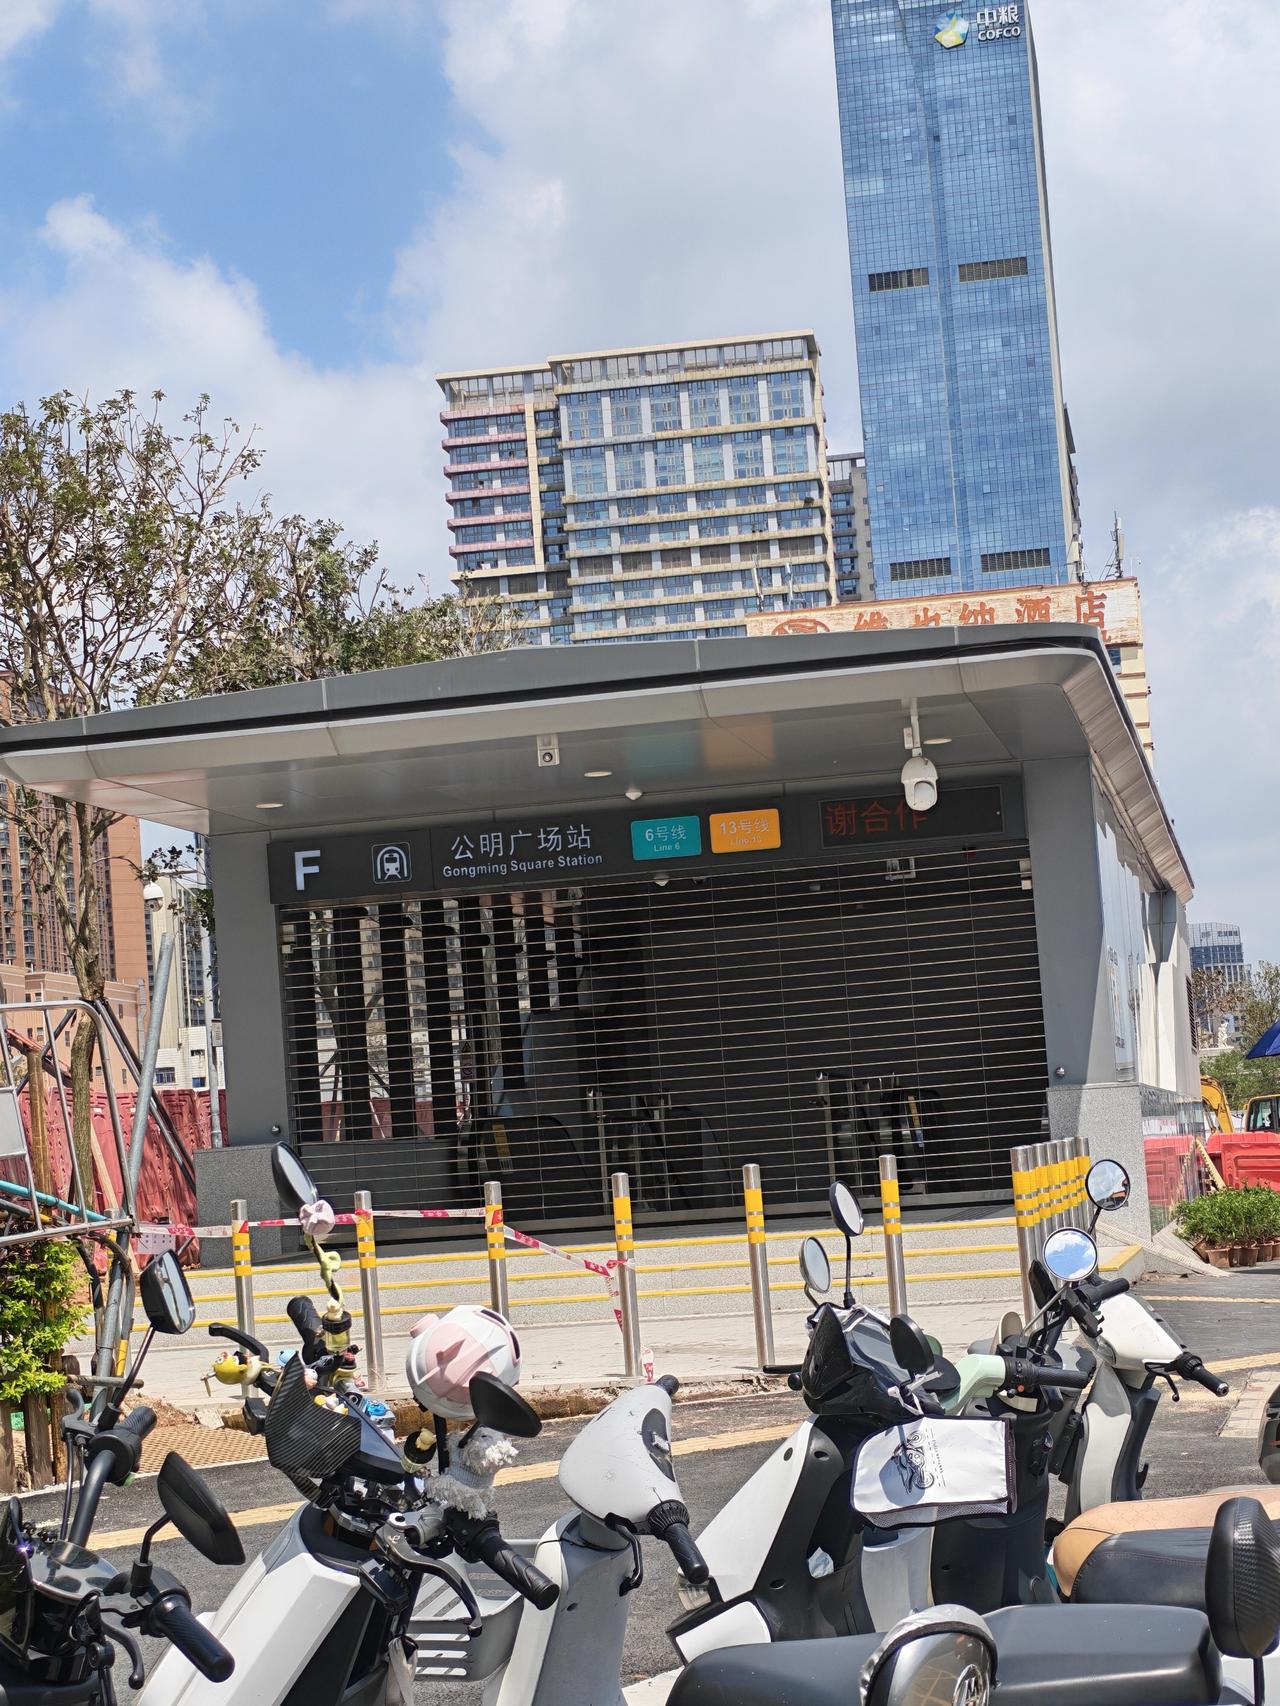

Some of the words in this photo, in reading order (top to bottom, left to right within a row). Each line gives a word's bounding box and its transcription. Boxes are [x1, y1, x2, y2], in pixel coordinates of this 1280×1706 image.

[977, 4, 1019, 26] 中粮
[978, 26, 1021, 41] COFCO
[645, 825, 687, 842] 6号线
[720, 817, 769, 834] 13号线
[451, 823, 592, 860] 公明广场站
[653, 843, 673, 852] Line
[674, 842, 681, 851] 6
[294, 849, 321, 891] F
[443, 862, 507, 878] Gongming
[510, 858, 554, 873] Square
[558, 854, 602, 868] Station
